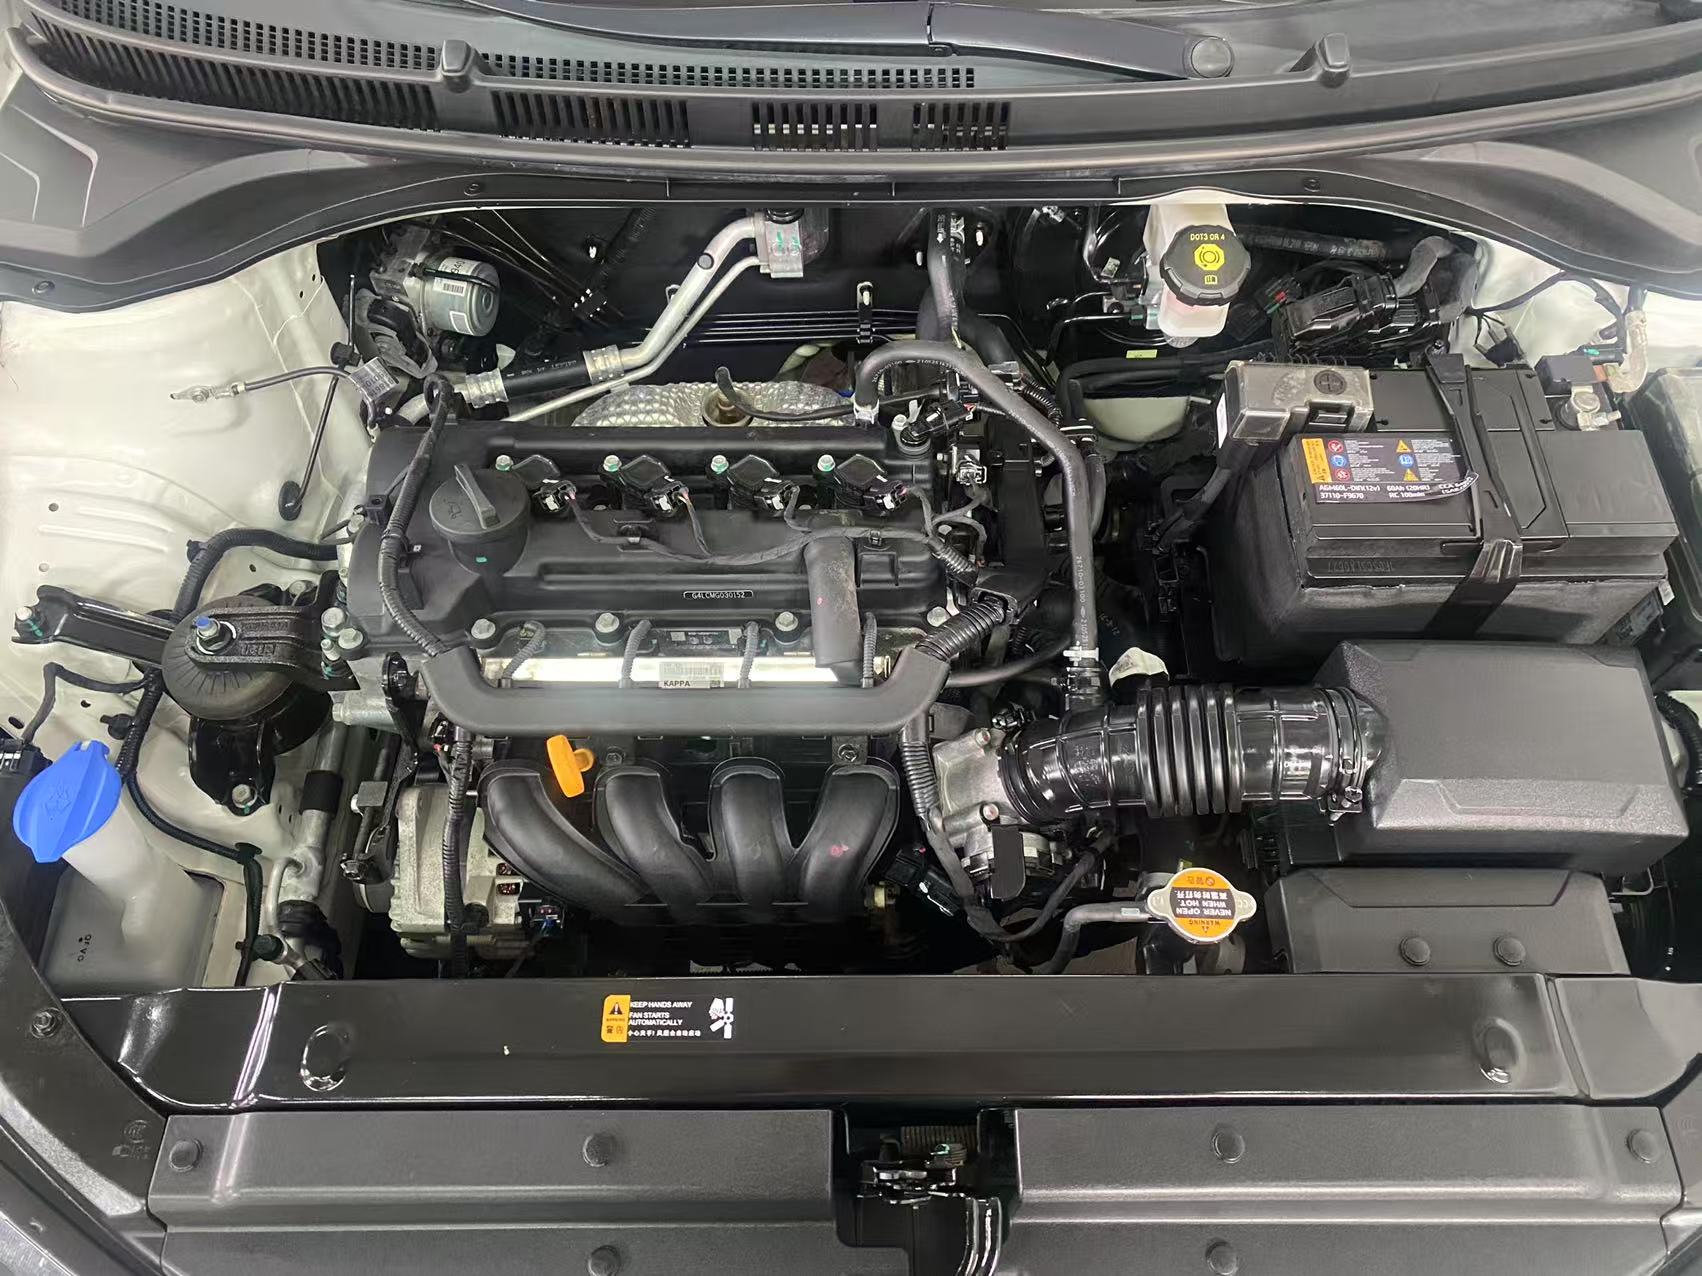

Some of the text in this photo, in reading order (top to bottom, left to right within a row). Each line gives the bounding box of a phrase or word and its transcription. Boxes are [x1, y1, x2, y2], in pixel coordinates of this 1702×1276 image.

[1190, 233, 1226, 241] DOT3 OR 4
[1178, 899, 1226, 908] WHEN HOT.
[1176, 907, 1232, 916] NEVER OPEN
